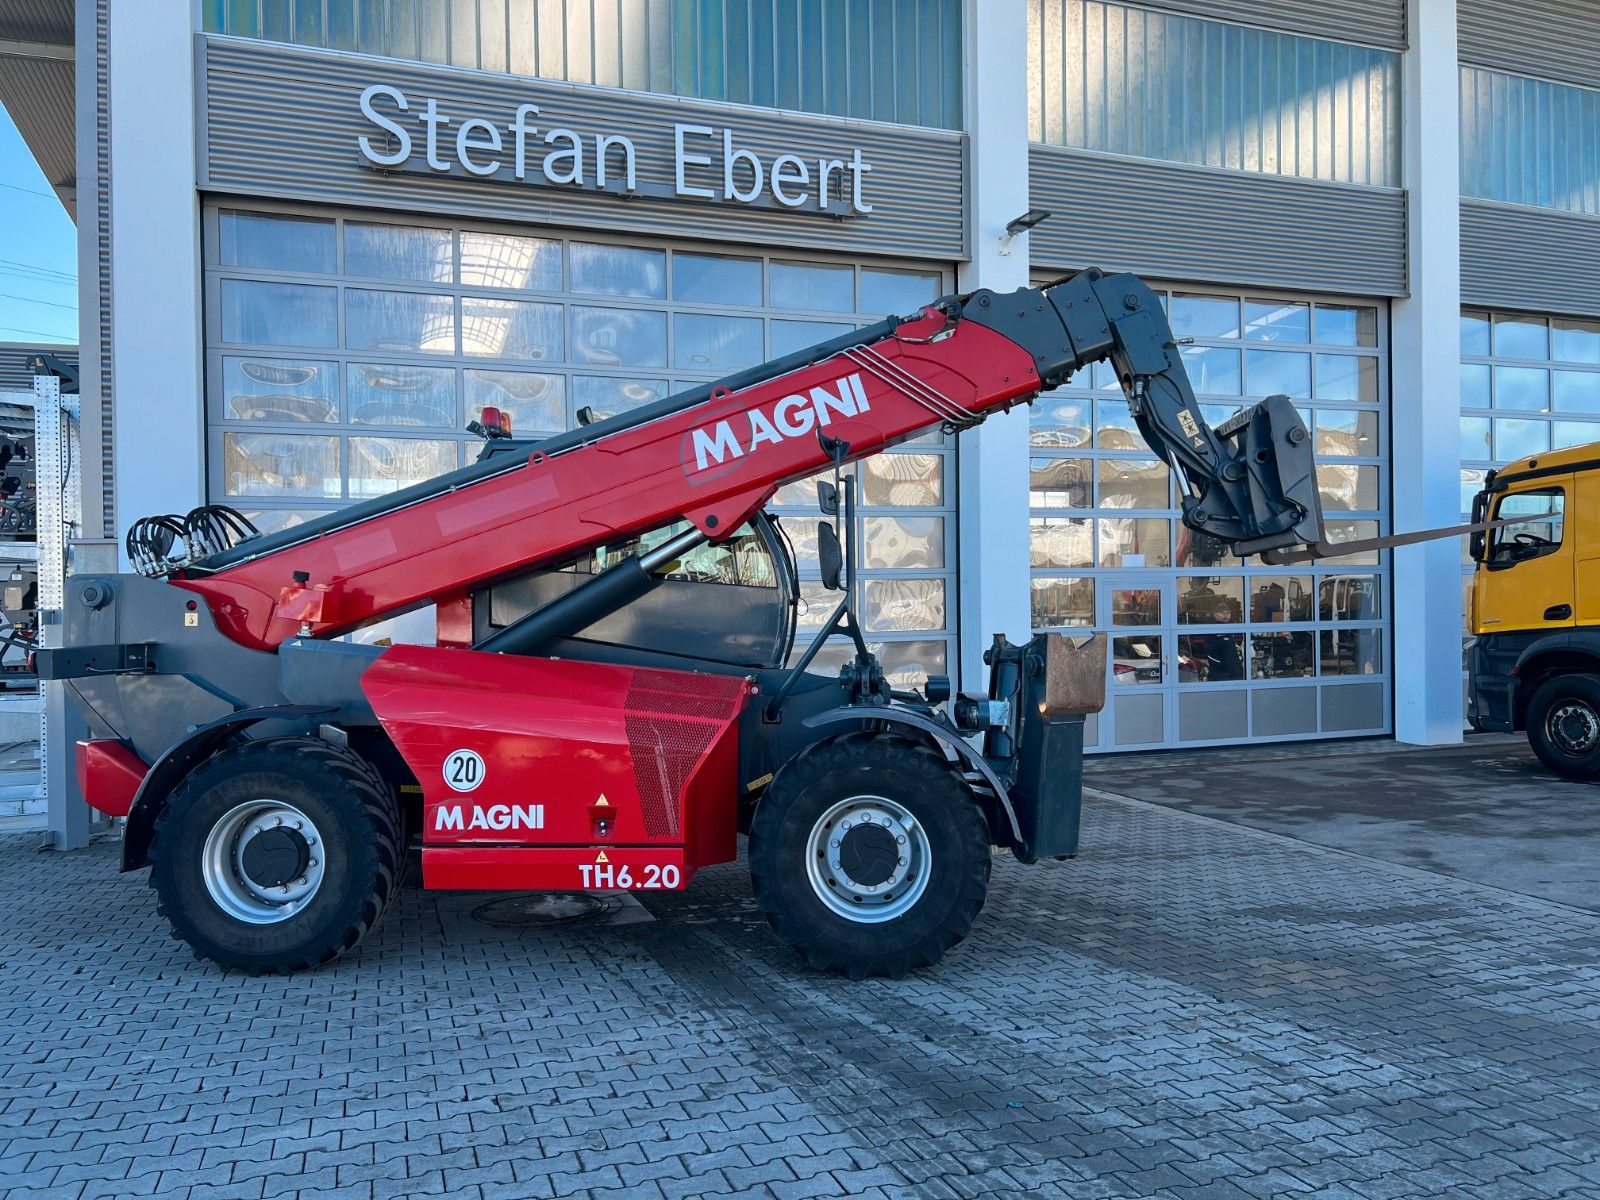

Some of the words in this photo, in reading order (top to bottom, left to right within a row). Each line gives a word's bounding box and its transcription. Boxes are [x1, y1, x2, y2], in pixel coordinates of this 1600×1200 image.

[358, 84, 636, 192] Stefan
[674, 123, 873, 214] Ebert
[692, 373, 871, 470] MAGNI
[452, 756, 477, 783] 20
[434, 804, 544, 831] MAGNI
[578, 864, 680, 889] TH6.20
